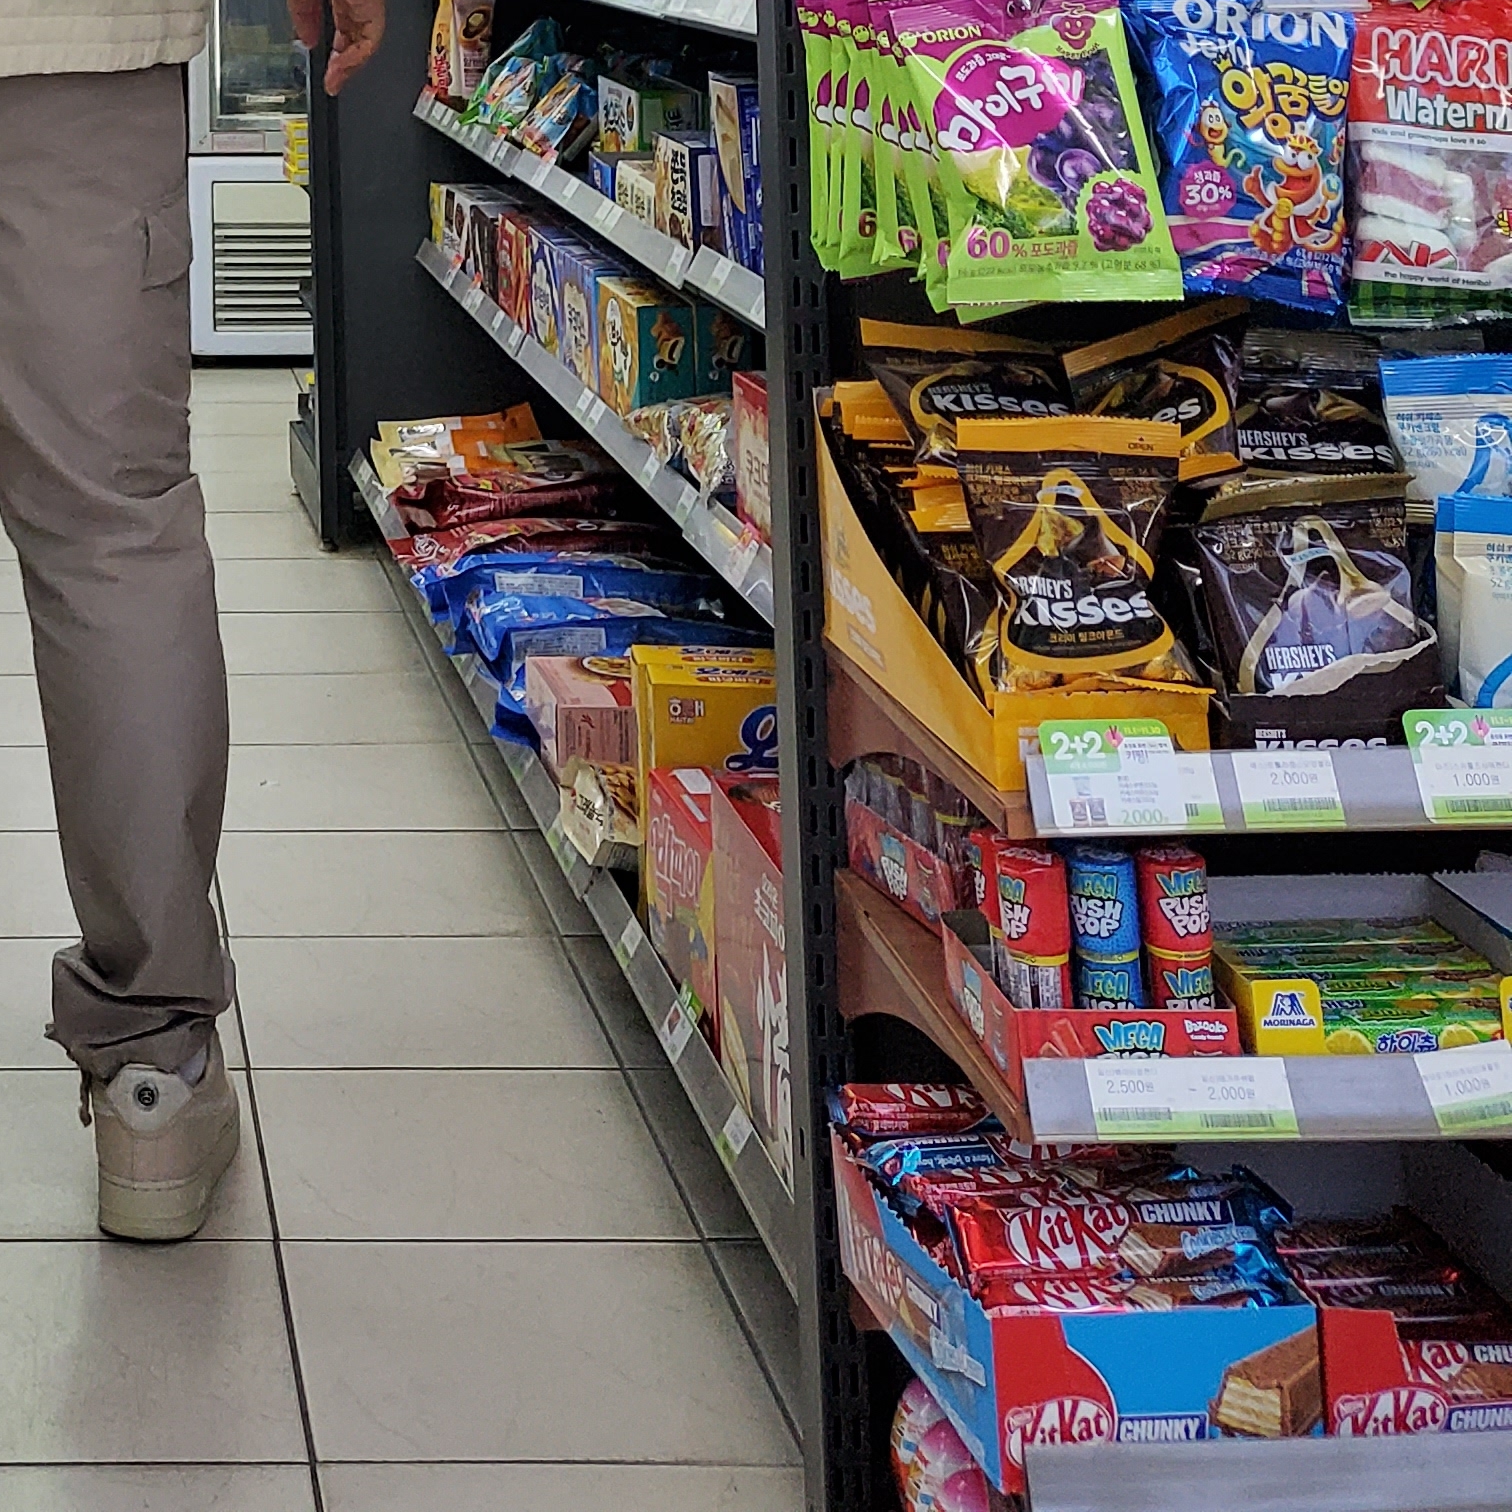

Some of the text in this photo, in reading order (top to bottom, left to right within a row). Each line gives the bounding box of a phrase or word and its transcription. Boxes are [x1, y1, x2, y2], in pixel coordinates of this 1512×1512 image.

[922, 25, 983, 44] ORION
[938, 64, 1085, 152] 마이구미
[1371, 127, 1389, 137] Kids
[1390, 128, 1406, 137] and
[1450, 136, 1468, 145] love
[1185, 183, 1233, 205] 30%
[1383, 270, 1398, 280] the
[1399, 271, 1426, 283] happy
[1427, 274, 1450, 285] world
[1127, 443, 1155, 452] OPEN
[1238, 429, 1309, 448] HERSHEY'S
[1265, 644, 1337, 670] HERSHEY'S
[1415, 720, 1471, 747] 2+2
[1050, 731, 1106, 761] 2+2
[1270, 771, 1319, 785] 2,000원
[1453, 772, 1501, 787] 1,000원
[1069, 895, 1124, 921] PUSH
[1074, 916, 1121, 938] POP
[1170, 911, 1211, 938] POP
[1184, 1018, 1228, 1035] Bazooka
[1263, 1018, 1316, 1028] MORINAGA
[1094, 1019, 1165, 1052] MEGA
[1105, 1079, 1155, 1094] 2,500원
[1207, 1085, 1256, 1100] 2,000원
[1443, 1077, 1491, 1097] 1,000원
[1019, 1199, 1222, 1271] KitKat CHUNKY
[1119, 1416, 1200, 1441] CHUNKY
